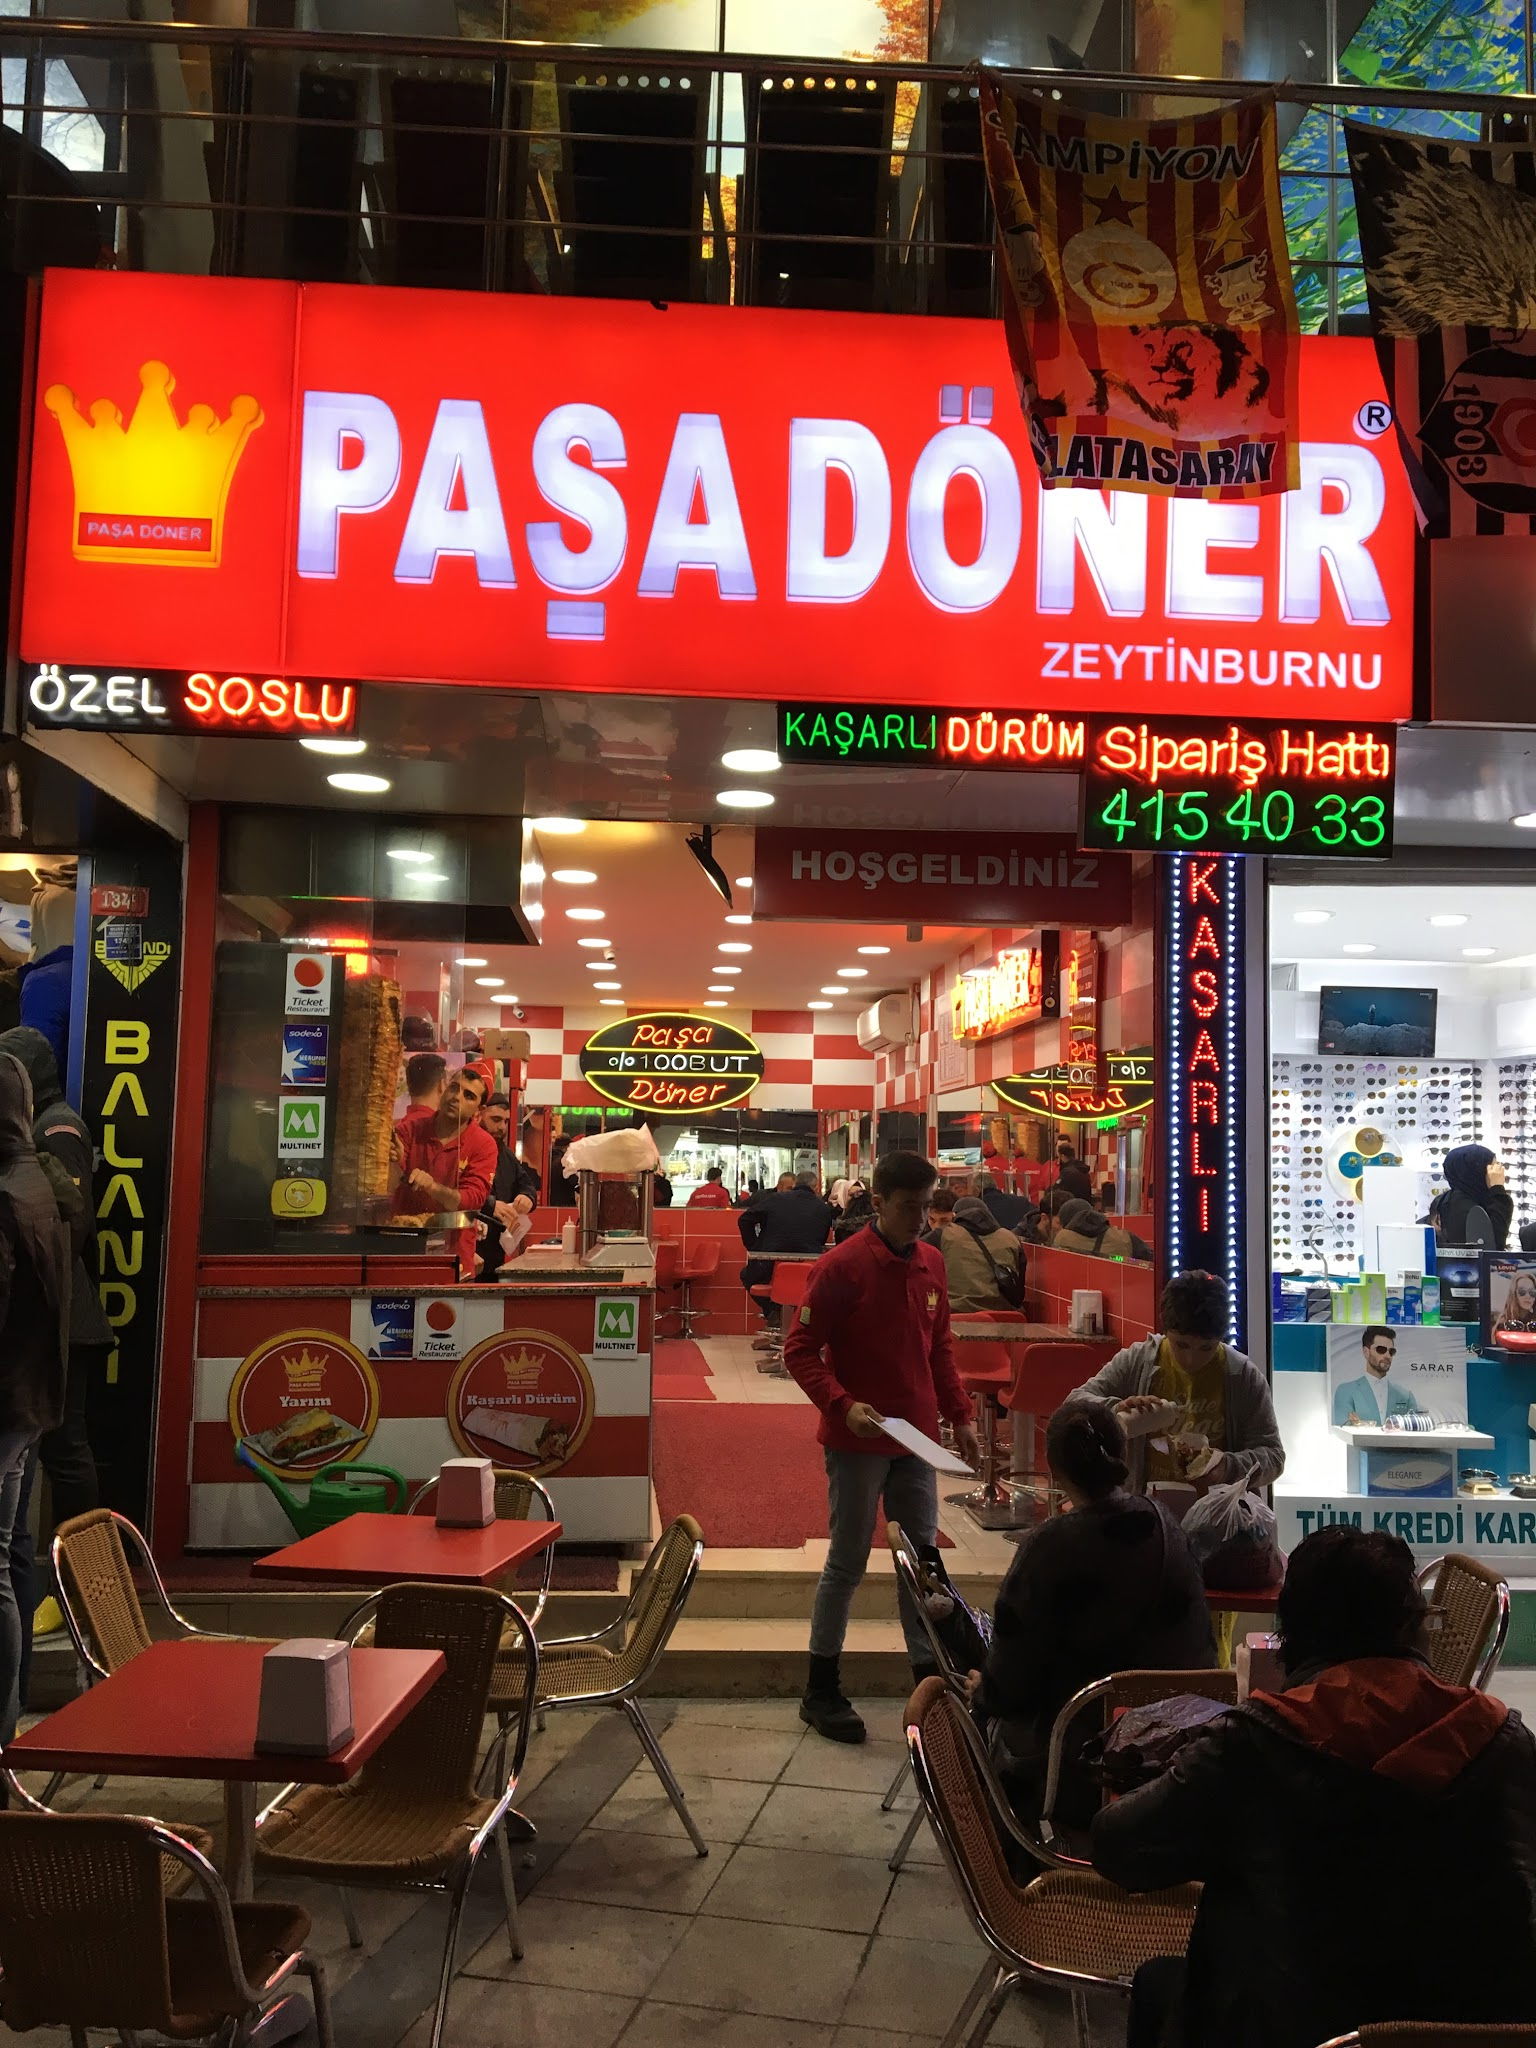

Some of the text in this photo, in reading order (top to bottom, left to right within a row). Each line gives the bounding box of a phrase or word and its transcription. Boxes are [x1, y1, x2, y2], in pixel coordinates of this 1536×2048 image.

[1453, 384, 1487, 477] 1903
[297, 385, 1391, 640] PAŞA DÖNER
[1040, 637, 1383, 690] ZEYTİNBURNU
[30, 663, 351, 723] ÖZEL SOSLU
[786, 711, 1085, 756] KAŞARLI DÜRÜM
[1100, 724, 1390, 785] Sipariş Hattı
[1102, 788, 1208, 842] 415
[1226, 788, 1295, 842] 40
[1311, 794, 1385, 847] 33
[792, 849, 1099, 890] HOŞGELDİNİZ
[292, 997, 323, 1007] Ticket
[289, 1027, 323, 1037] sodexo
[631, 1024, 713, 1049] Paşa
[628, 1079, 727, 1104] Döner
[280, 1142, 322, 1150] MULTINET
[424, 1341, 456, 1351] Ticket
[1410, 1363, 1454, 1373] SARAR
[524, 1393, 577, 1404] Dürüm
[1387, 1470, 1422, 1480] ELEGANCE
[1373, 1503, 1464, 1544] KREDİ
